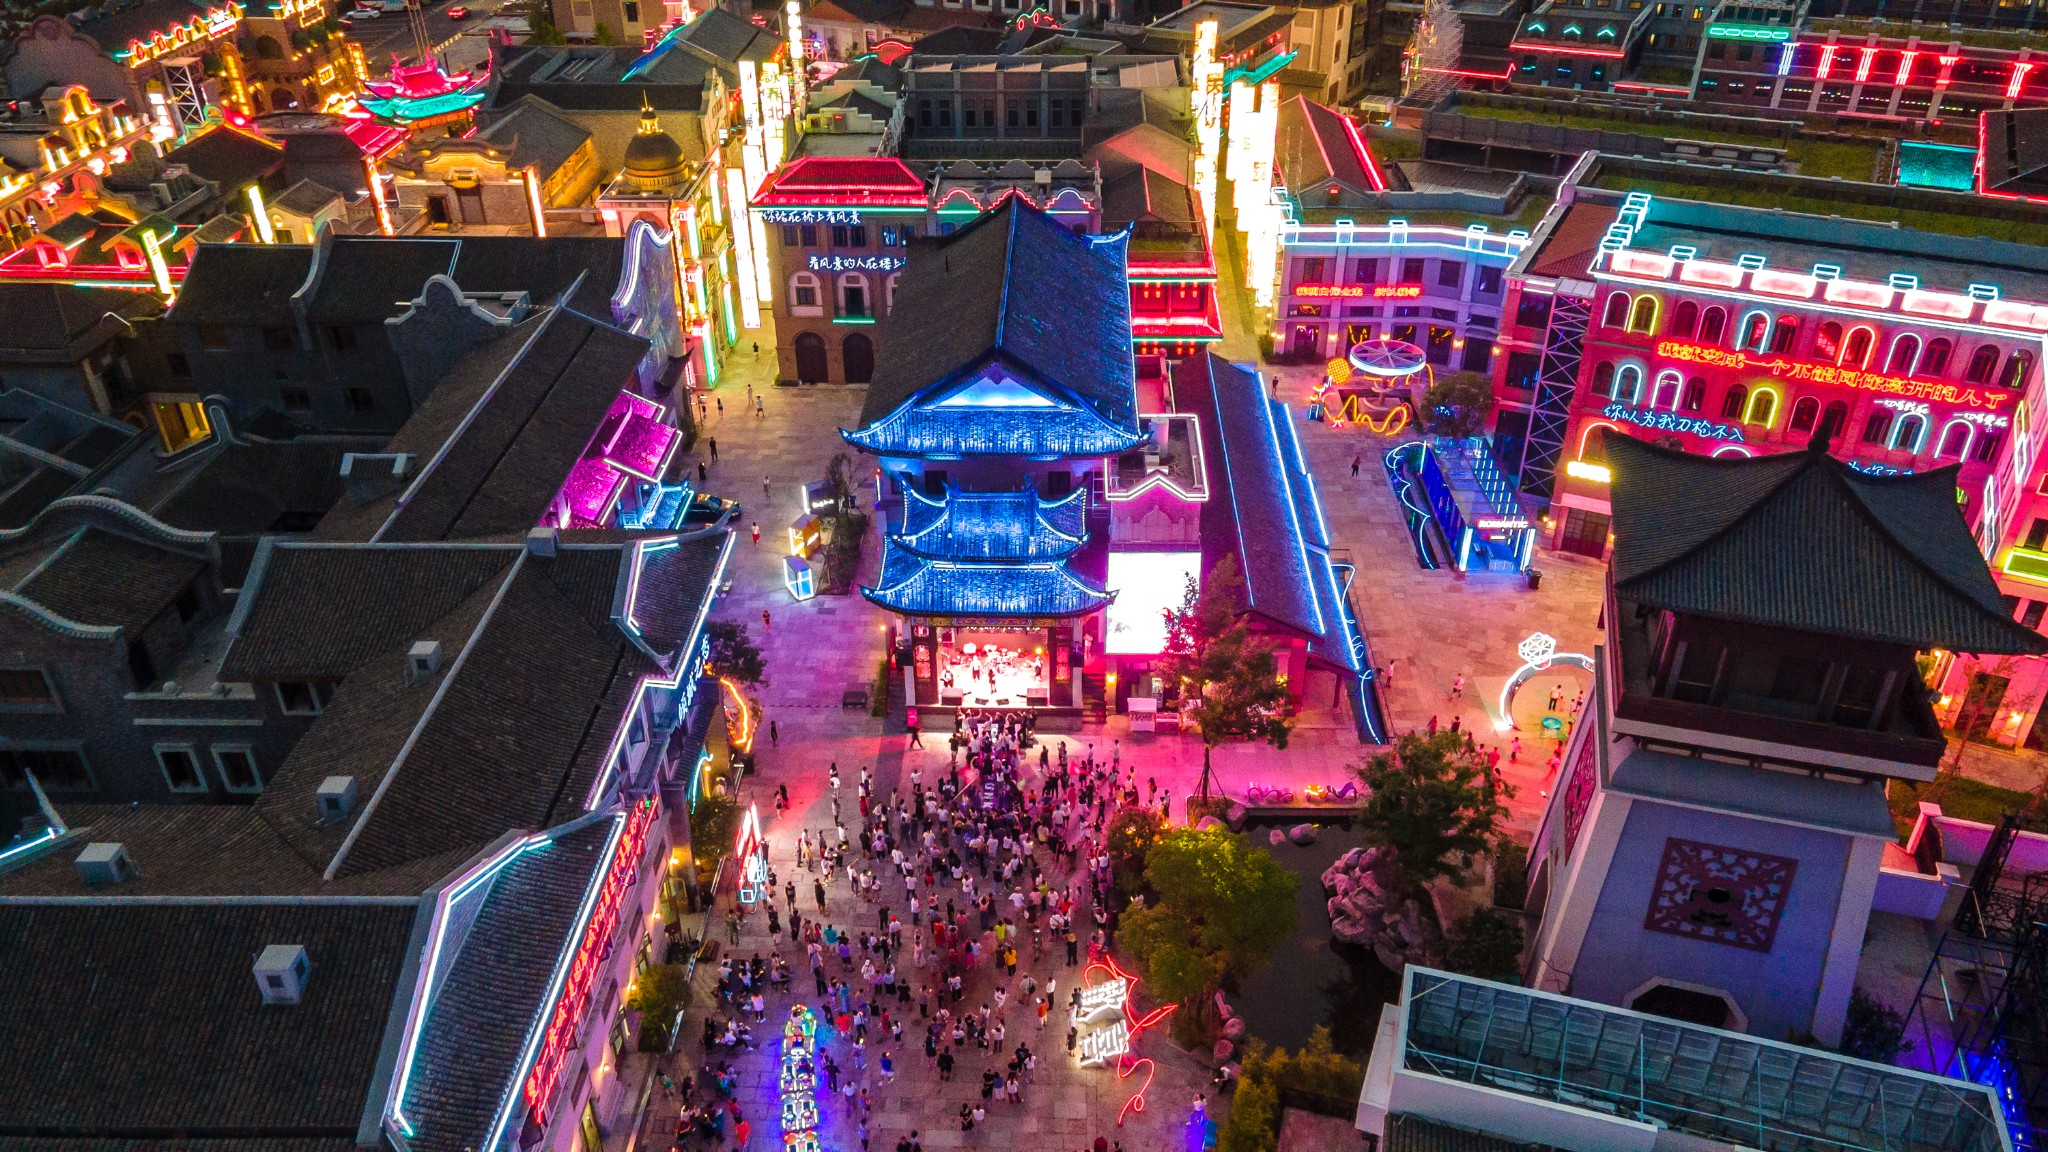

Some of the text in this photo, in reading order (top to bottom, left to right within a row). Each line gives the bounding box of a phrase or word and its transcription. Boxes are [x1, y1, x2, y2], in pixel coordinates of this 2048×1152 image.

[762, 210, 861, 224] 你站在桥上看风景
[809, 256, 906, 270] 看风景的人在楼上
[1603, 403, 1744, 441] 你以为我刀枪不入
